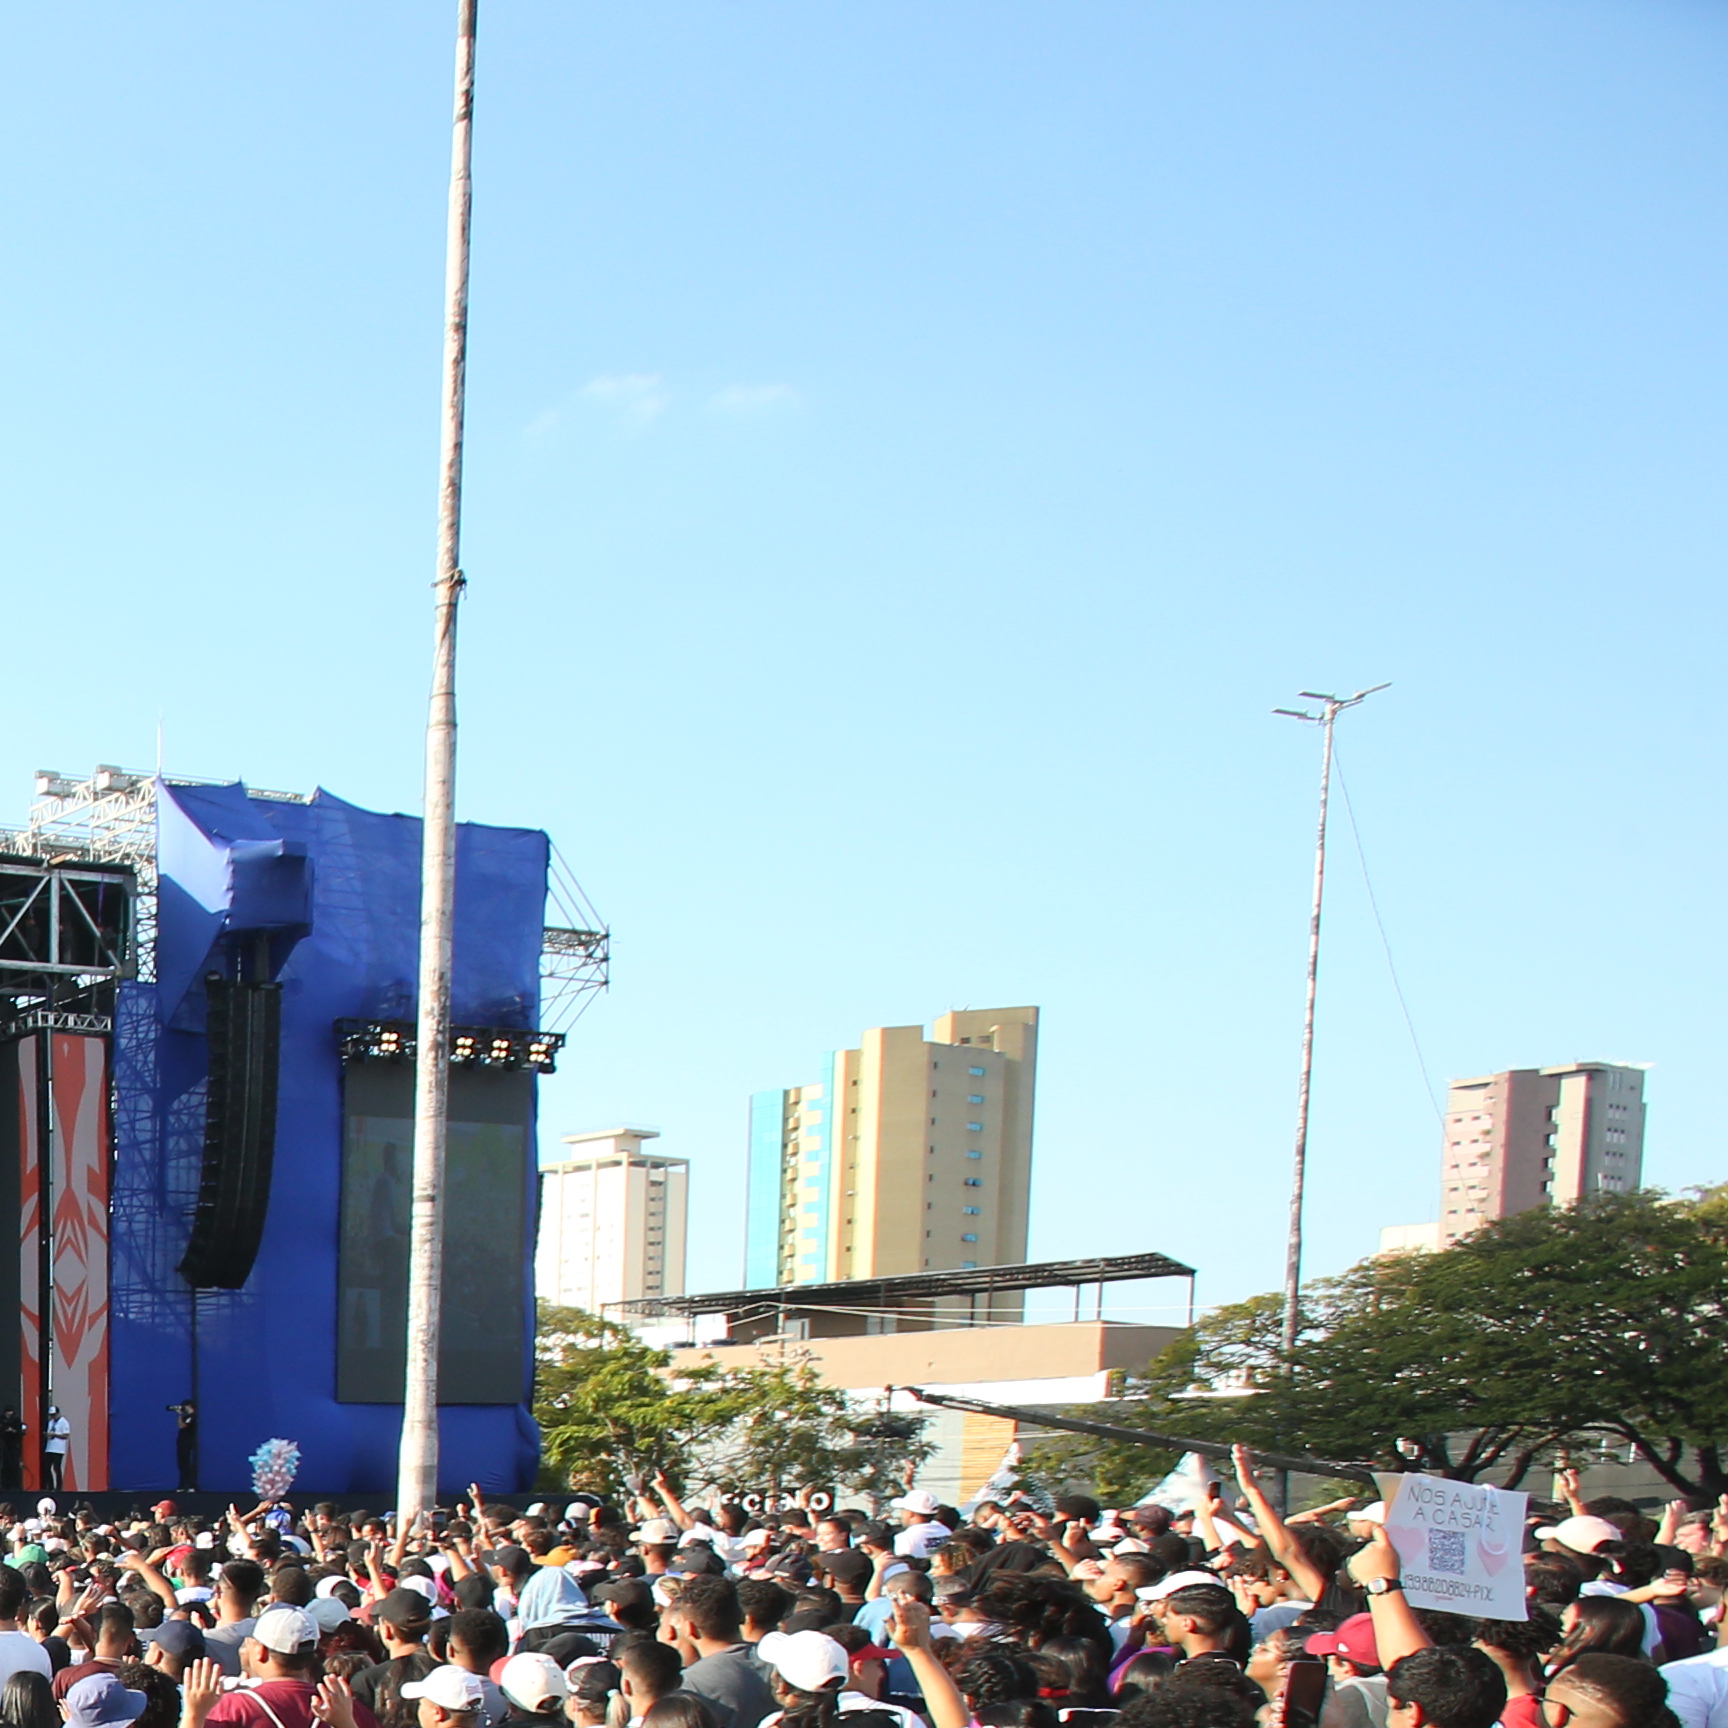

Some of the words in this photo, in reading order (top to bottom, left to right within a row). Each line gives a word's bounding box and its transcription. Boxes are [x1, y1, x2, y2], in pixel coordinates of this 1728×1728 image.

[1408, 1485, 1446, 1507] NOS
[1412, 1506, 1426, 1521] A
[1432, 1508, 1495, 1532] CASAR
